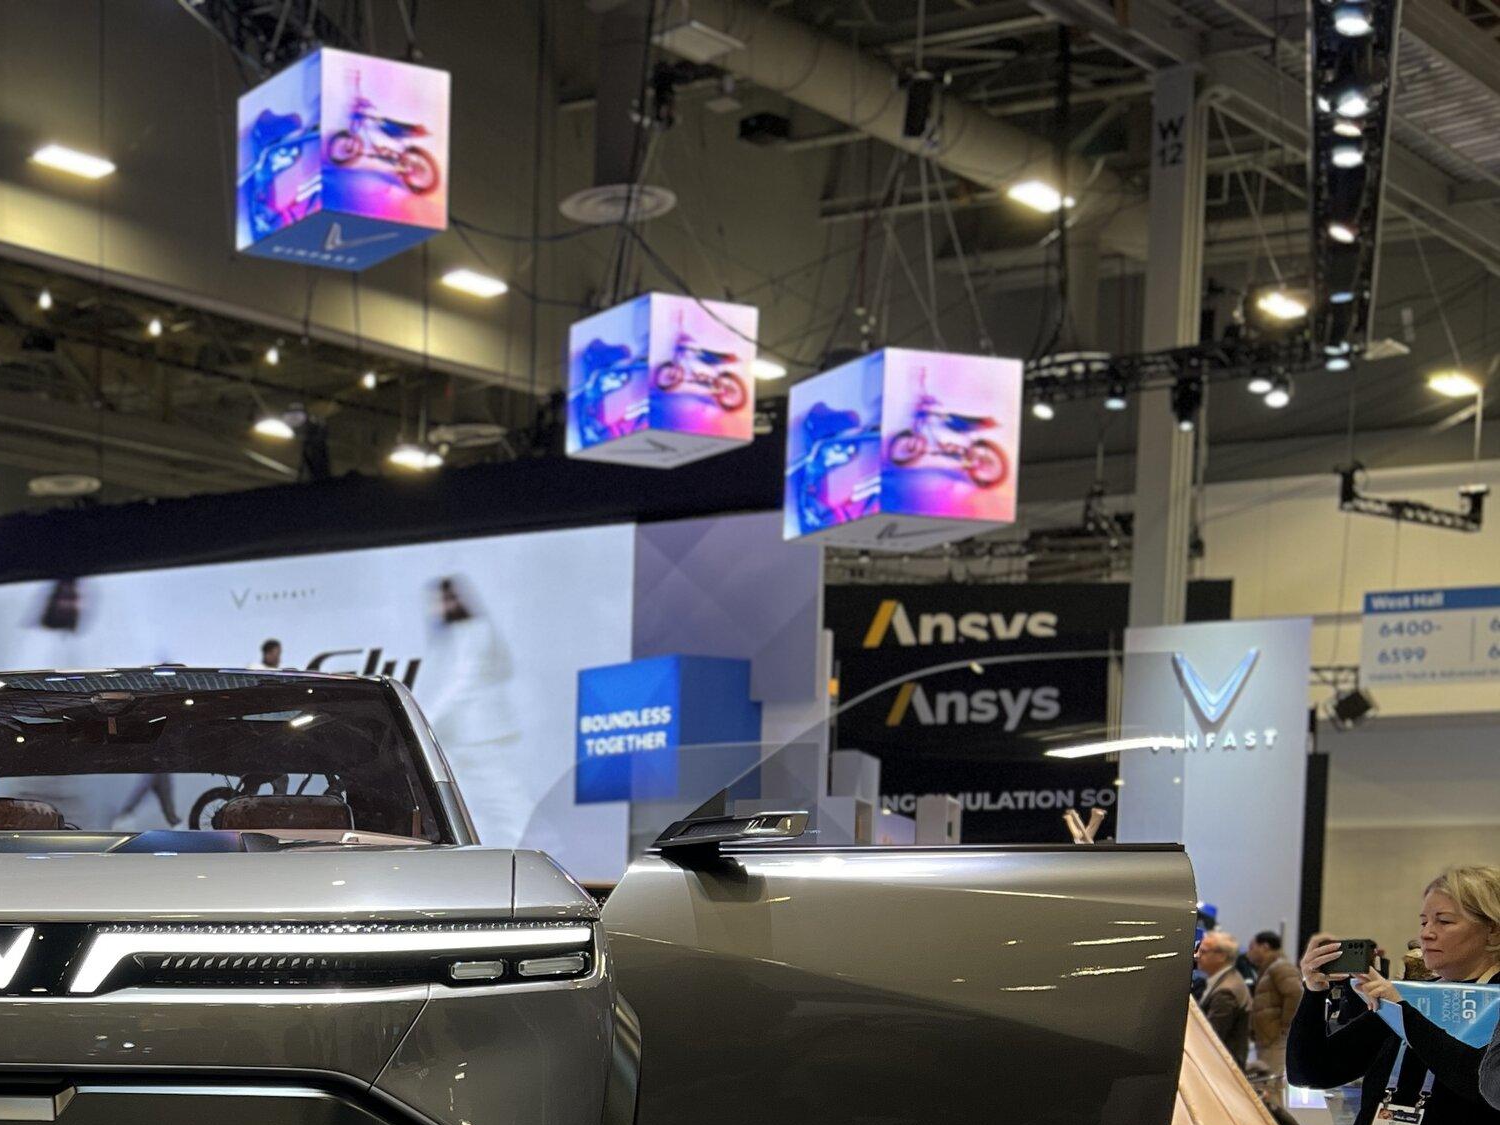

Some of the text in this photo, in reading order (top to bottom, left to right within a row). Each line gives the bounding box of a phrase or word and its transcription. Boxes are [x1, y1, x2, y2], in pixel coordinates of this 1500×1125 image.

[1159, 116, 1184, 140] W
[581, 705, 671, 734] BOUNDLESS
[886, 682, 1062, 732] Ansys
[585, 731, 667, 756] TOGETHER
